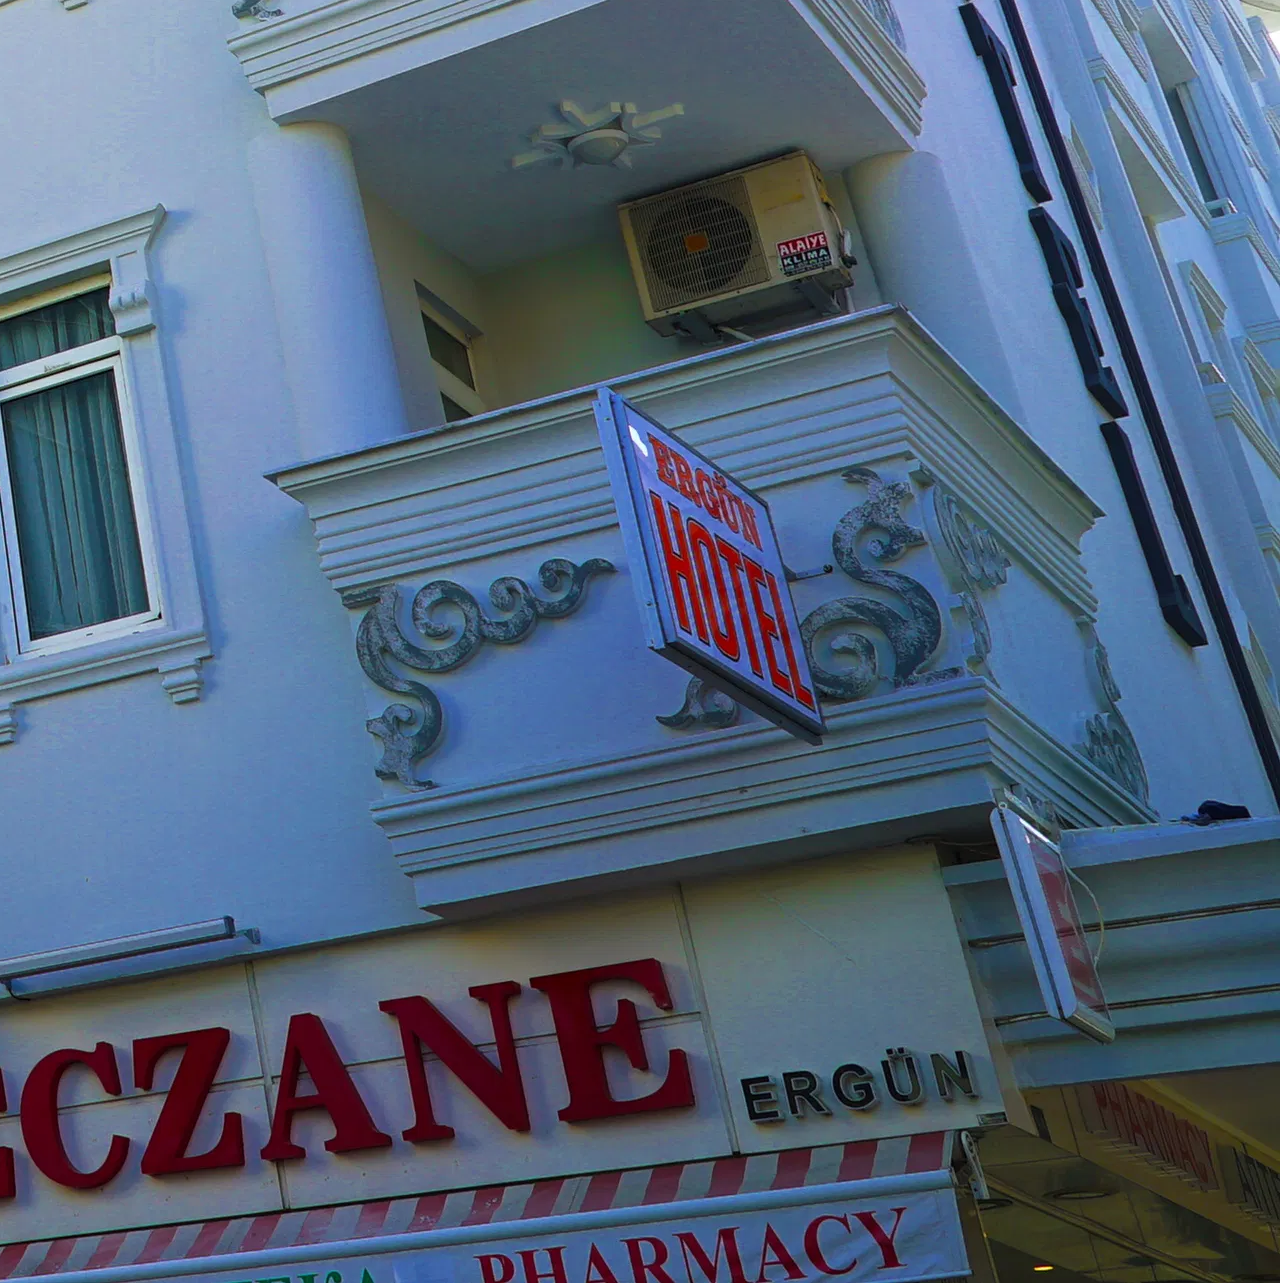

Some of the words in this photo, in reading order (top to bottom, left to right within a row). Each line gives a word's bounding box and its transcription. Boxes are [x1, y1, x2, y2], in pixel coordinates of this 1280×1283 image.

[647, 432, 763, 552] ERGÜN
[649, 489, 816, 711] HOTEL
[740, 1046, 980, 1124] ERGÜN
[473, 1207, 909, 1283] PHARMACY
